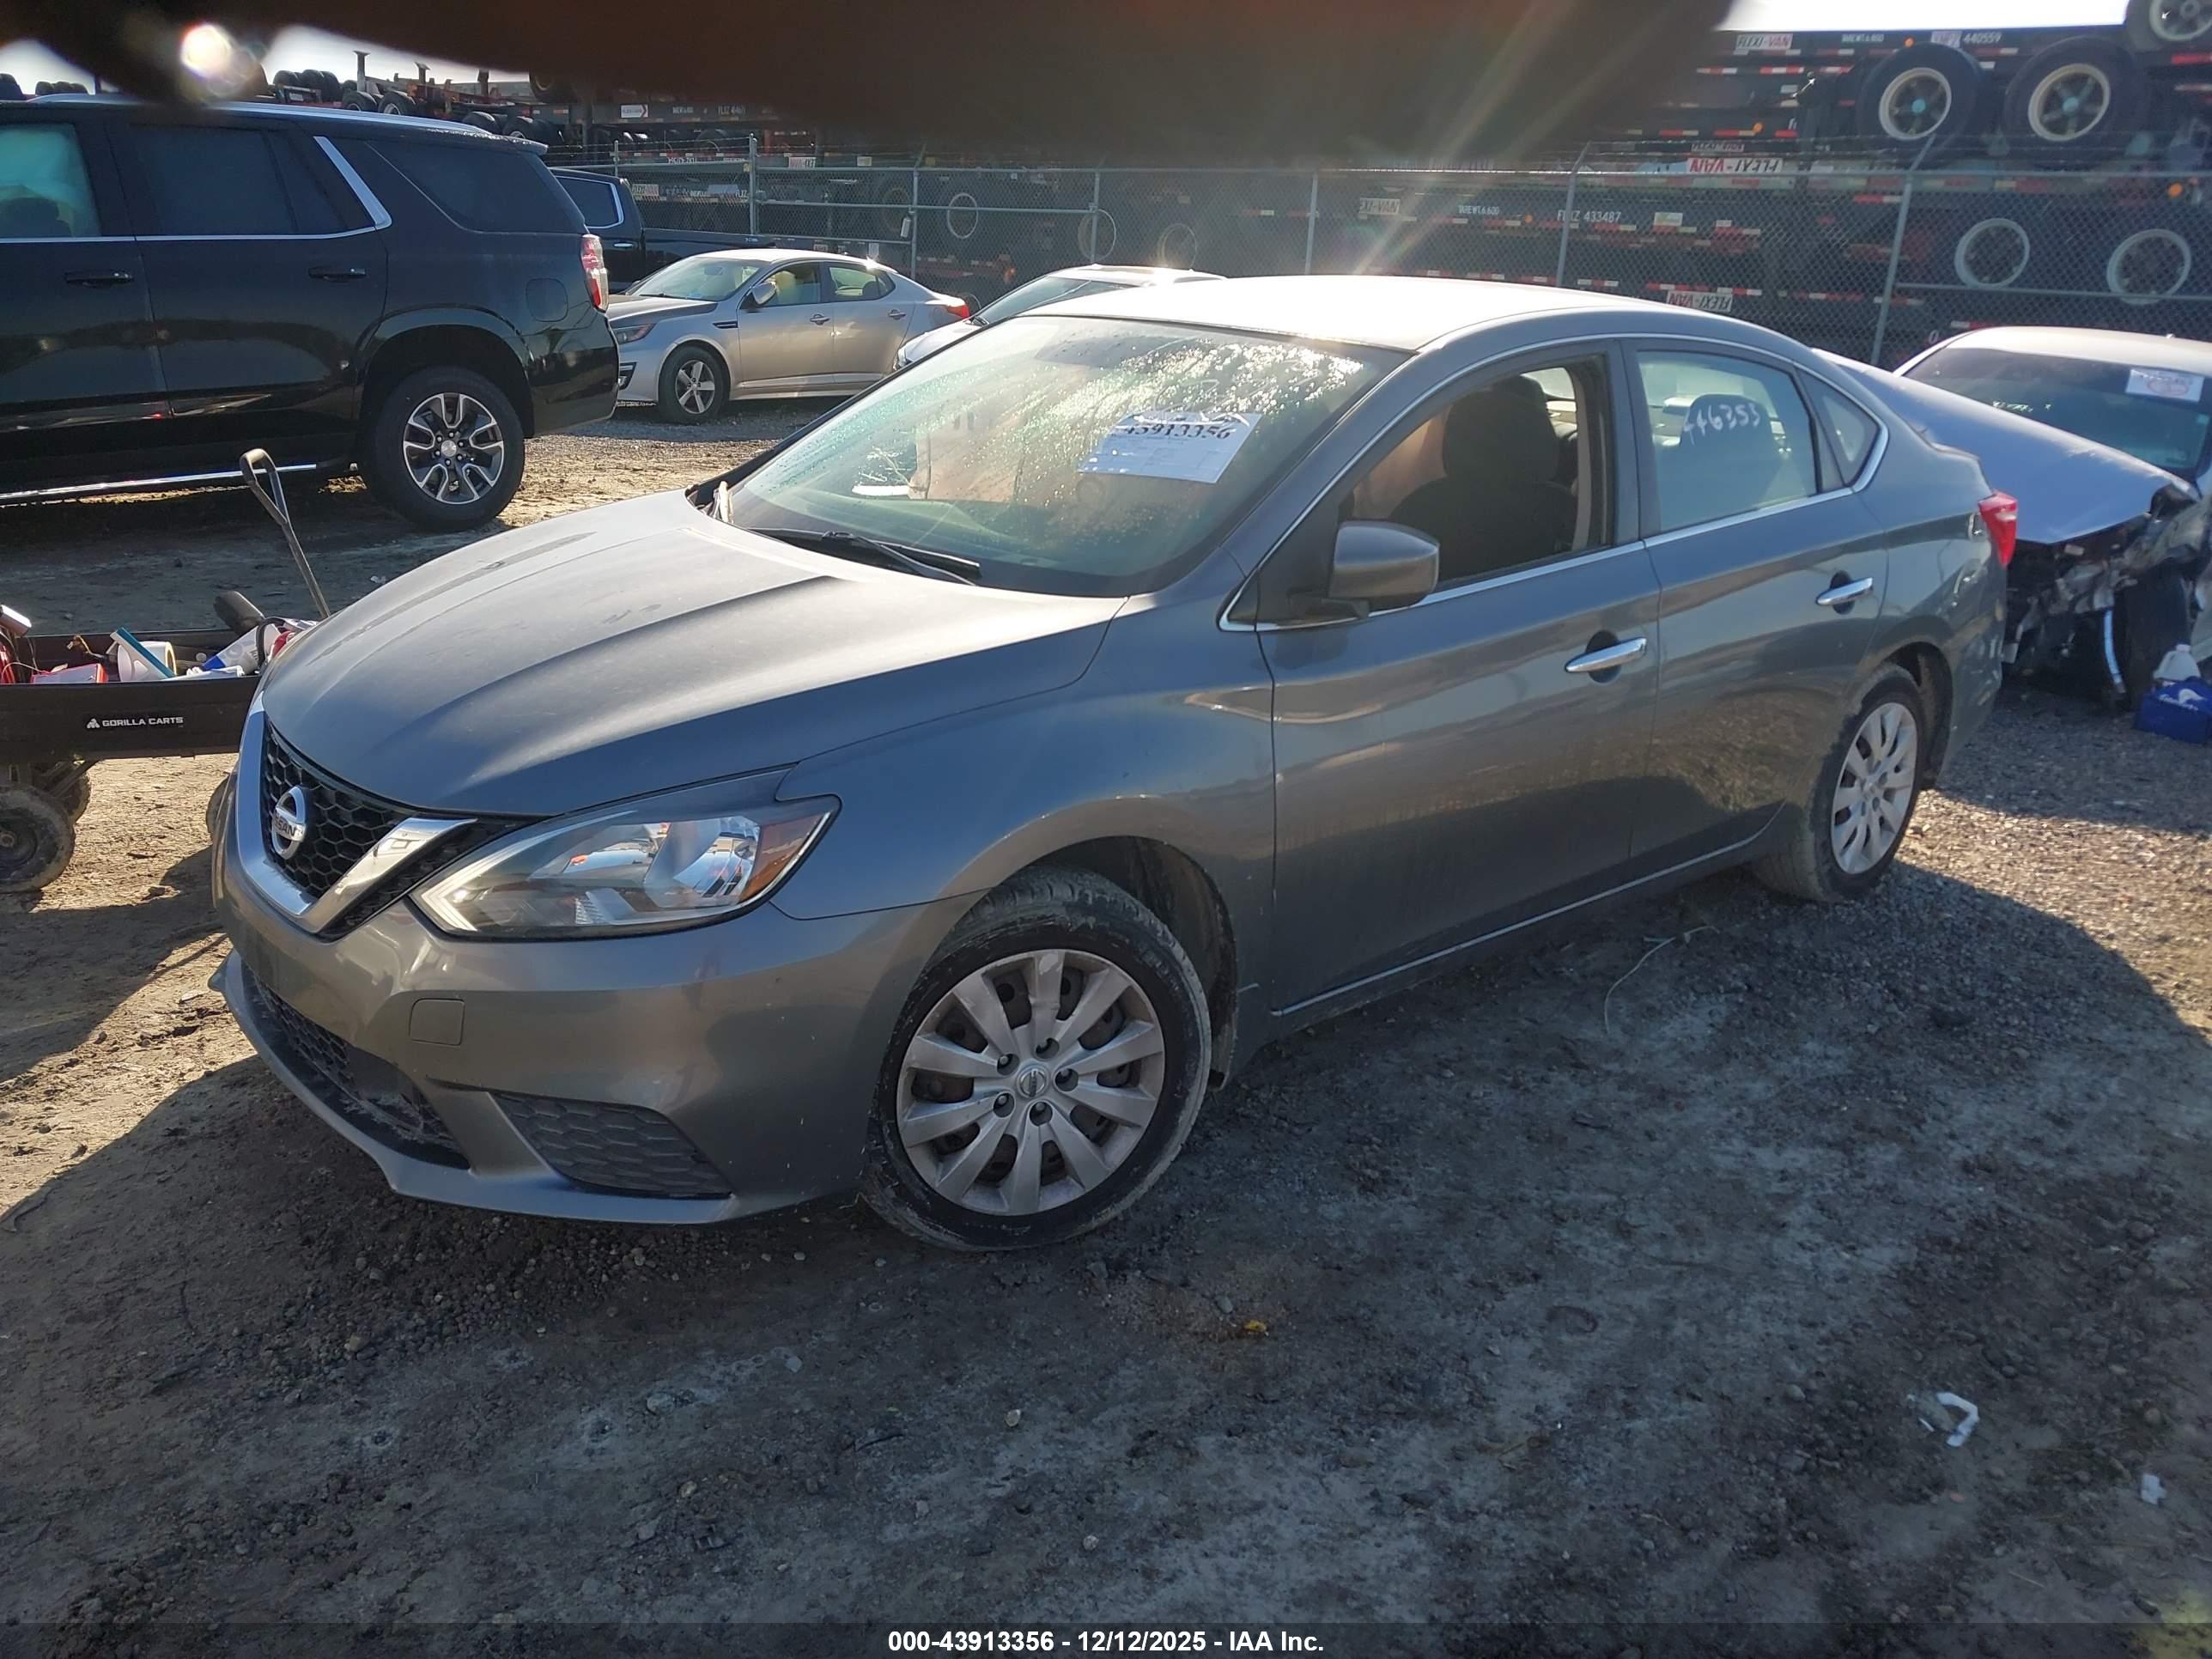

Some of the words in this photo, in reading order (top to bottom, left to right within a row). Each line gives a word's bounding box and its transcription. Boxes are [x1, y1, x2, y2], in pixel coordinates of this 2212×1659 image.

[1689, 159, 1781, 172] FLEXI-VAN
[1583, 211, 1621, 222] 433487
[102, 719, 146, 727] GORILLA
